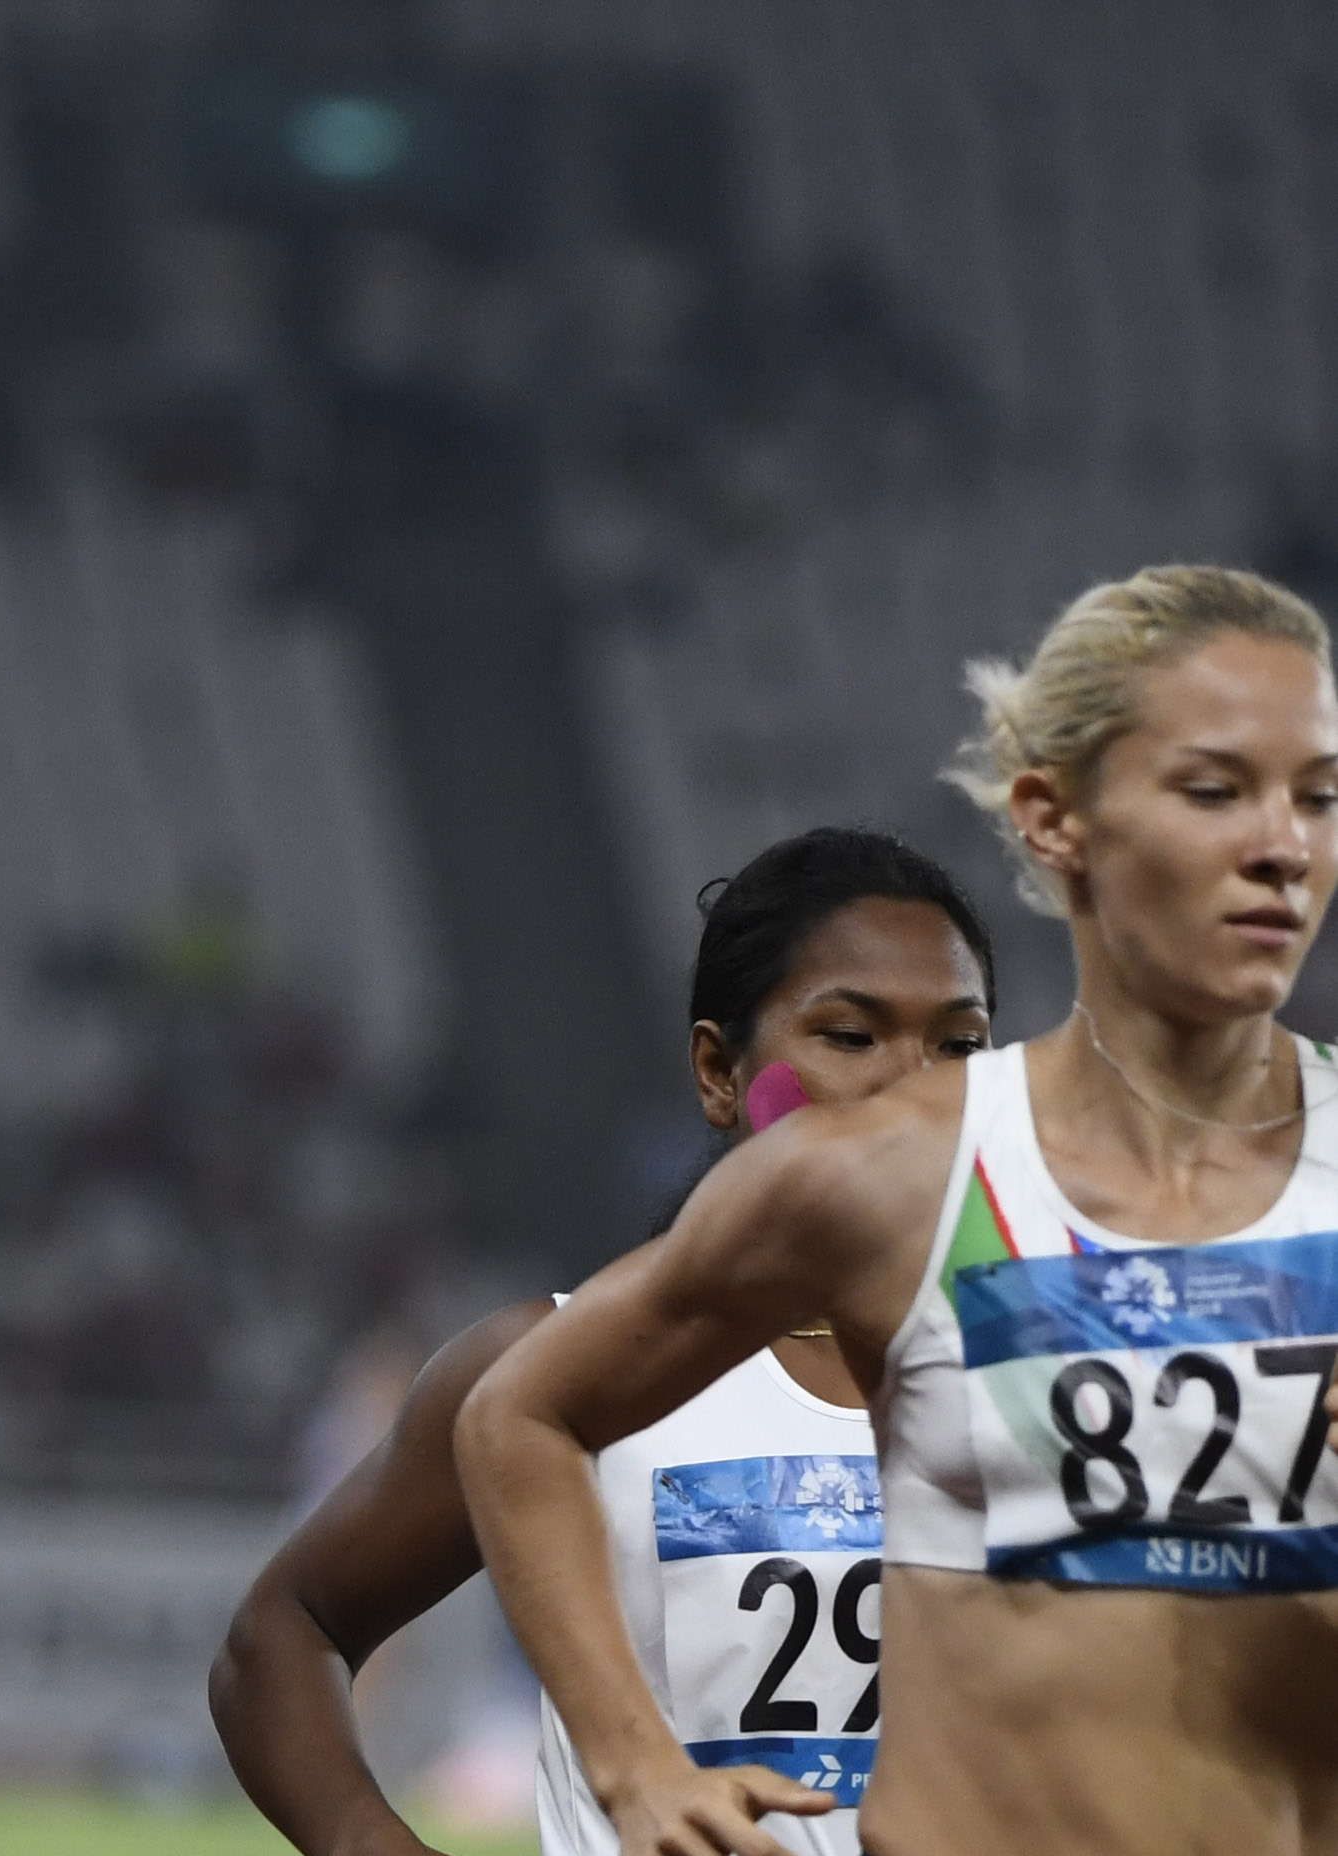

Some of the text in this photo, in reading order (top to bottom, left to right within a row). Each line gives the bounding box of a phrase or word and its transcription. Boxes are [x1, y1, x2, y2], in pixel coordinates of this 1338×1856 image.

[1049, 1343, 1338, 1530] 827
[738, 1557, 883, 1733] 29
[1190, 1540, 1266, 1579] BNI
